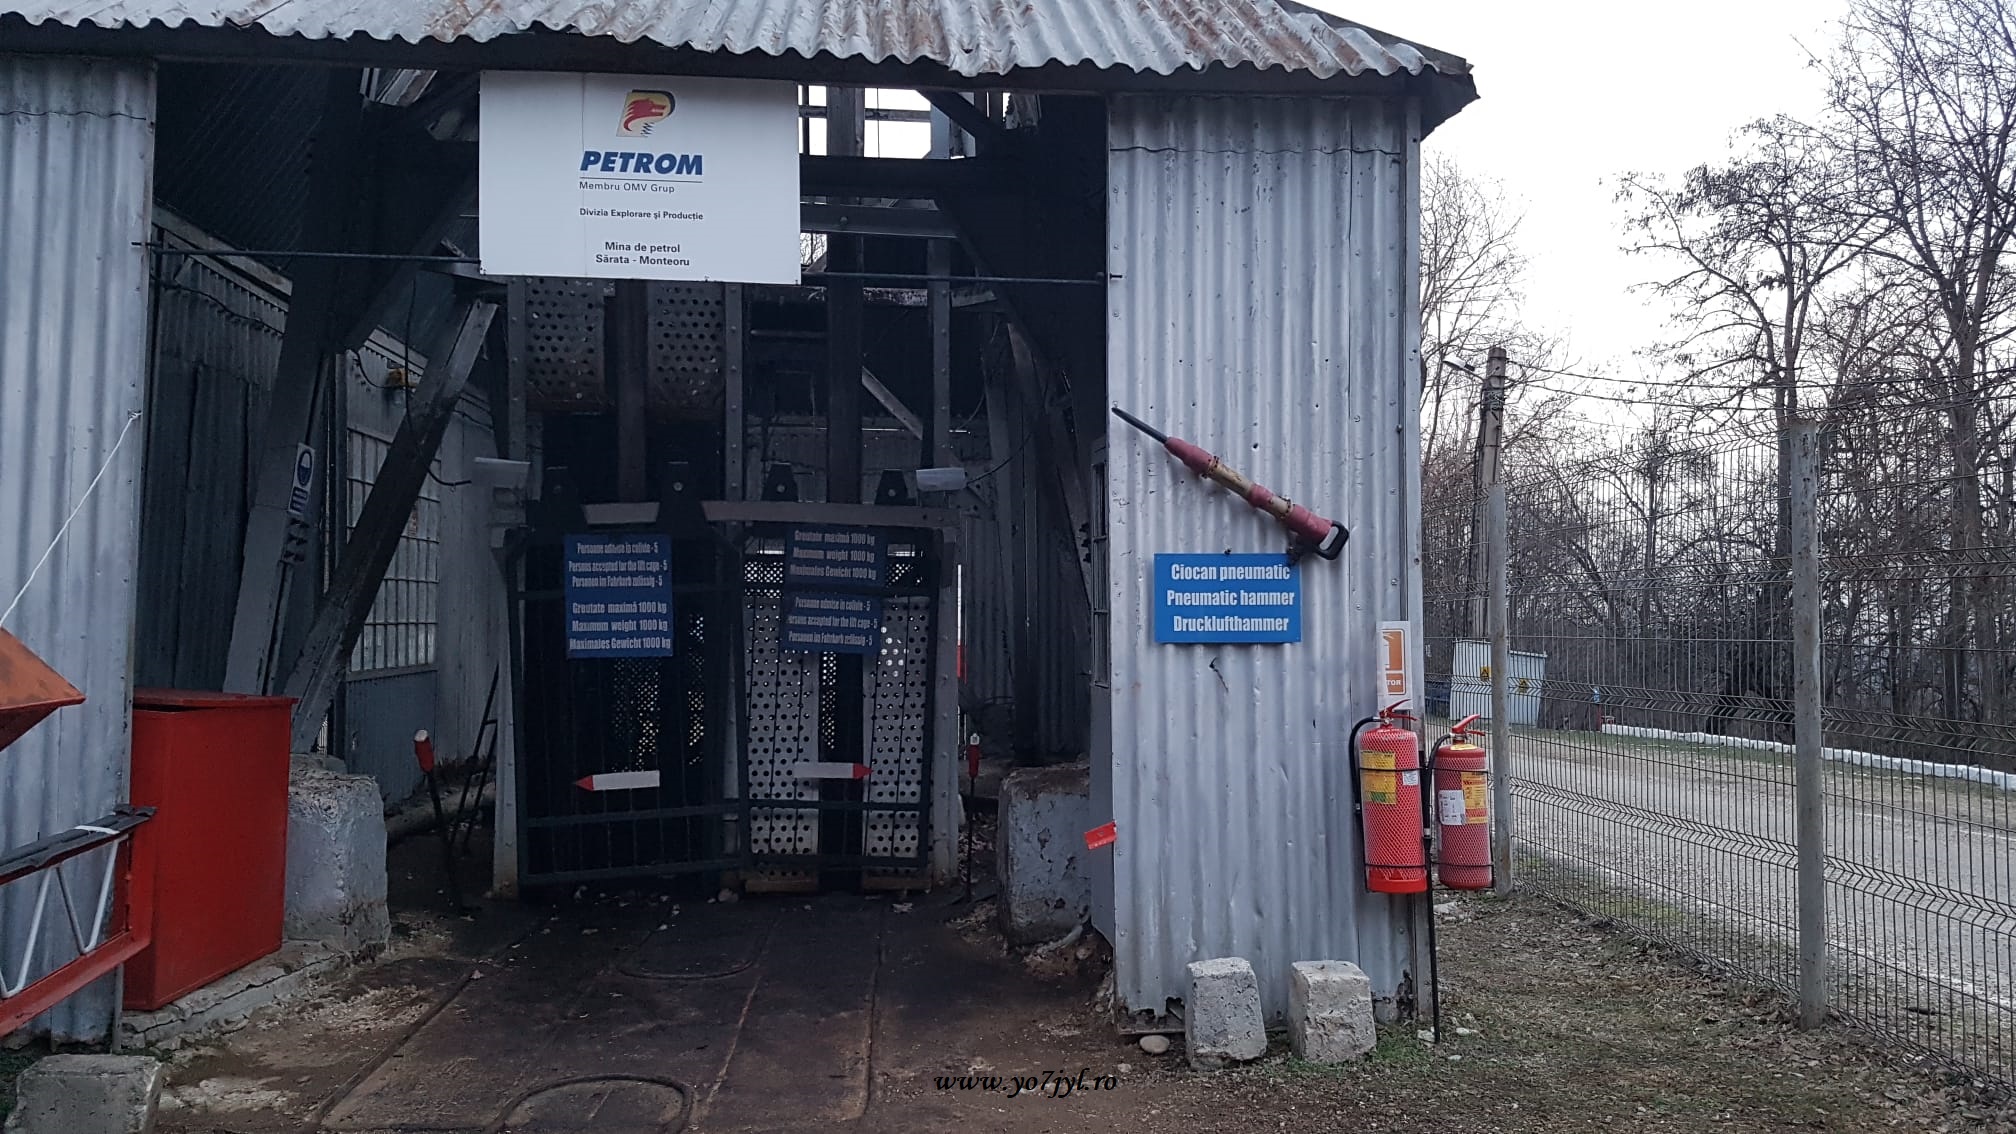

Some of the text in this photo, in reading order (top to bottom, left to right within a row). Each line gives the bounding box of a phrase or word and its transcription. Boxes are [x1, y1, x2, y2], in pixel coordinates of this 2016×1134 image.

[580, 150, 703, 175] PETROM
[579, 181, 675, 194] Membru OMV Grup
[579, 208, 609, 217] Divizia
[610, 209, 651, 219] Explorare
[605, 241, 680, 253] Mina de petrol
[595, 254, 630, 264] Sărata
[639, 255, 690, 266] Monteoru
[850, 533, 866, 545] 1000
[866, 534, 875, 546] kg
[826, 550, 848, 561] weight
[850, 550, 866, 562] 1000
[866, 551, 875, 563] kg
[568, 560, 592, 572] Persons
[592, 560, 619, 573] accepted
[619, 560, 627, 571] for
[627, 560, 637, 571] the
[645, 561, 660, 573] cage
[825, 566, 851, 578] Gewicht
[852, 567, 868, 579] 1000
[868, 568, 877, 580] kg
[1171, 563, 1291, 581] Ciocan pneumatic
[1166, 589, 1295, 606] Pneumatic hammer
[638, 601, 657, 613] 1000
[657, 601, 667, 614] kg
[571, 619, 668, 632] Maximum weight 1000 kg
[840, 616, 849, 627] the
[1173, 615, 1289, 632] Drucklufthammer
[569, 636, 671, 650] Maximales Gewicht 1000 kg
